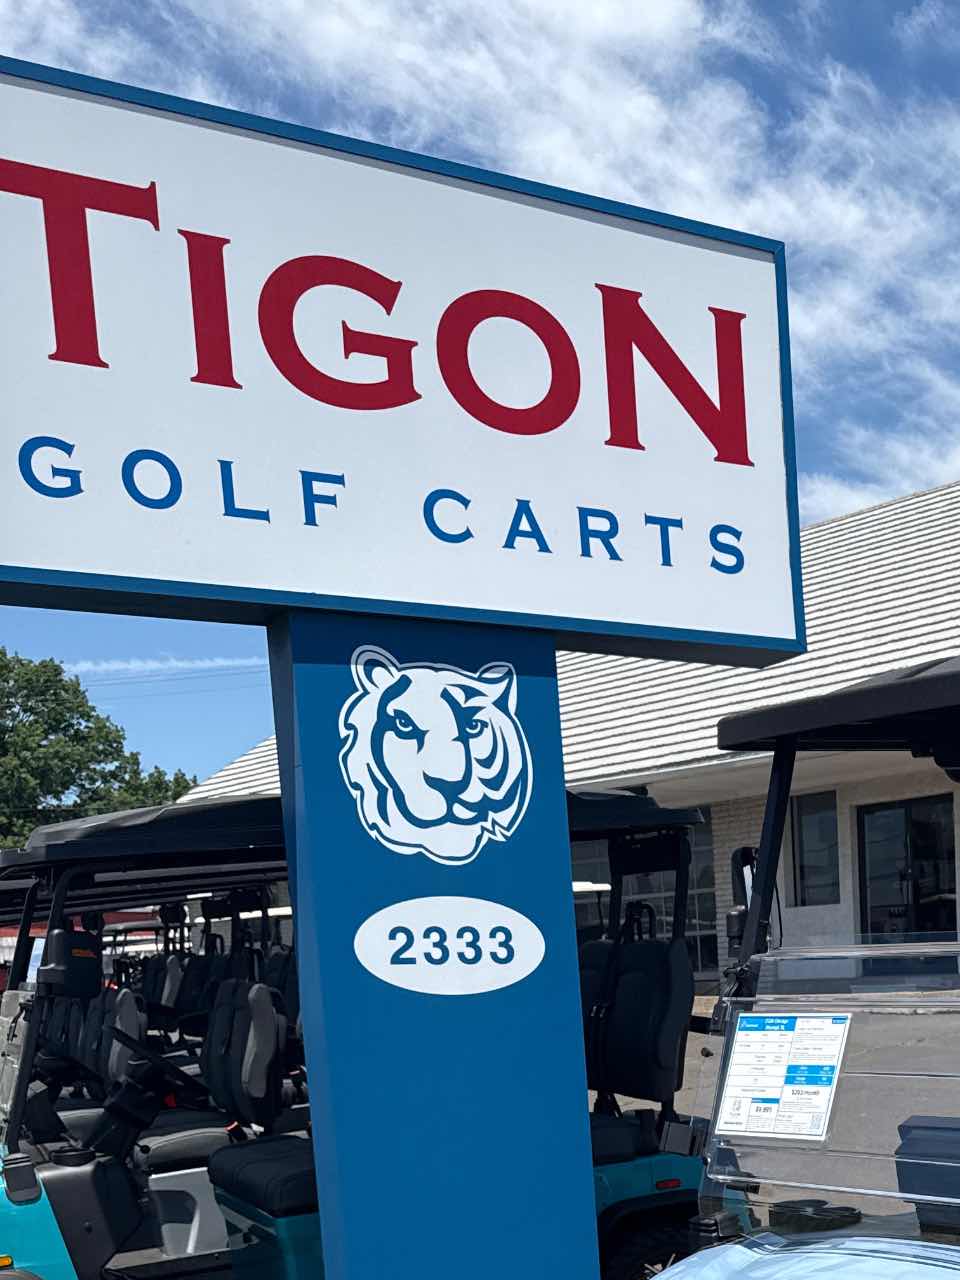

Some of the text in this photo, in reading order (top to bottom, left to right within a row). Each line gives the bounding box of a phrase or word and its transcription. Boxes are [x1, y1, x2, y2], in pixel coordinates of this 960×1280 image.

[0, 159, 751, 467] TIGON
[18, 435, 745, 576] GOLF CARTS
[387, 925, 516, 966] 2333
